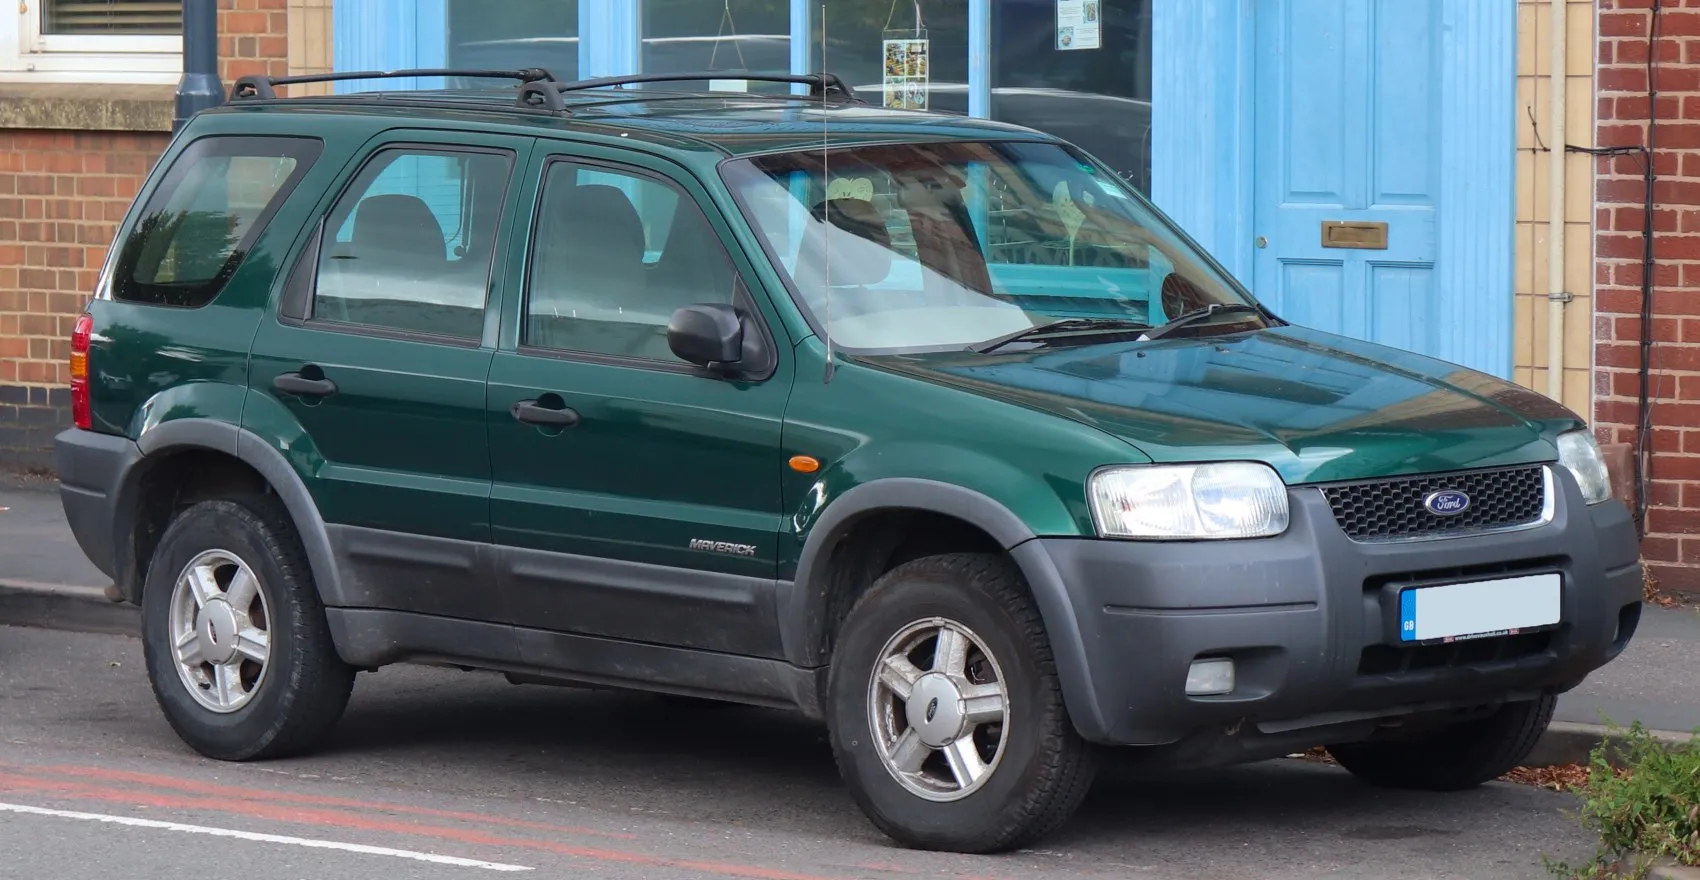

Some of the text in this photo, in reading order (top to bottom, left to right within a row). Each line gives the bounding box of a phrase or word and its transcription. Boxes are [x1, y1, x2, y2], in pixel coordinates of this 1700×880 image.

[1437, 495, 1460, 510] Ford
[689, 538, 757, 556] MAVERICK
[1404, 620, 1414, 631] GB
